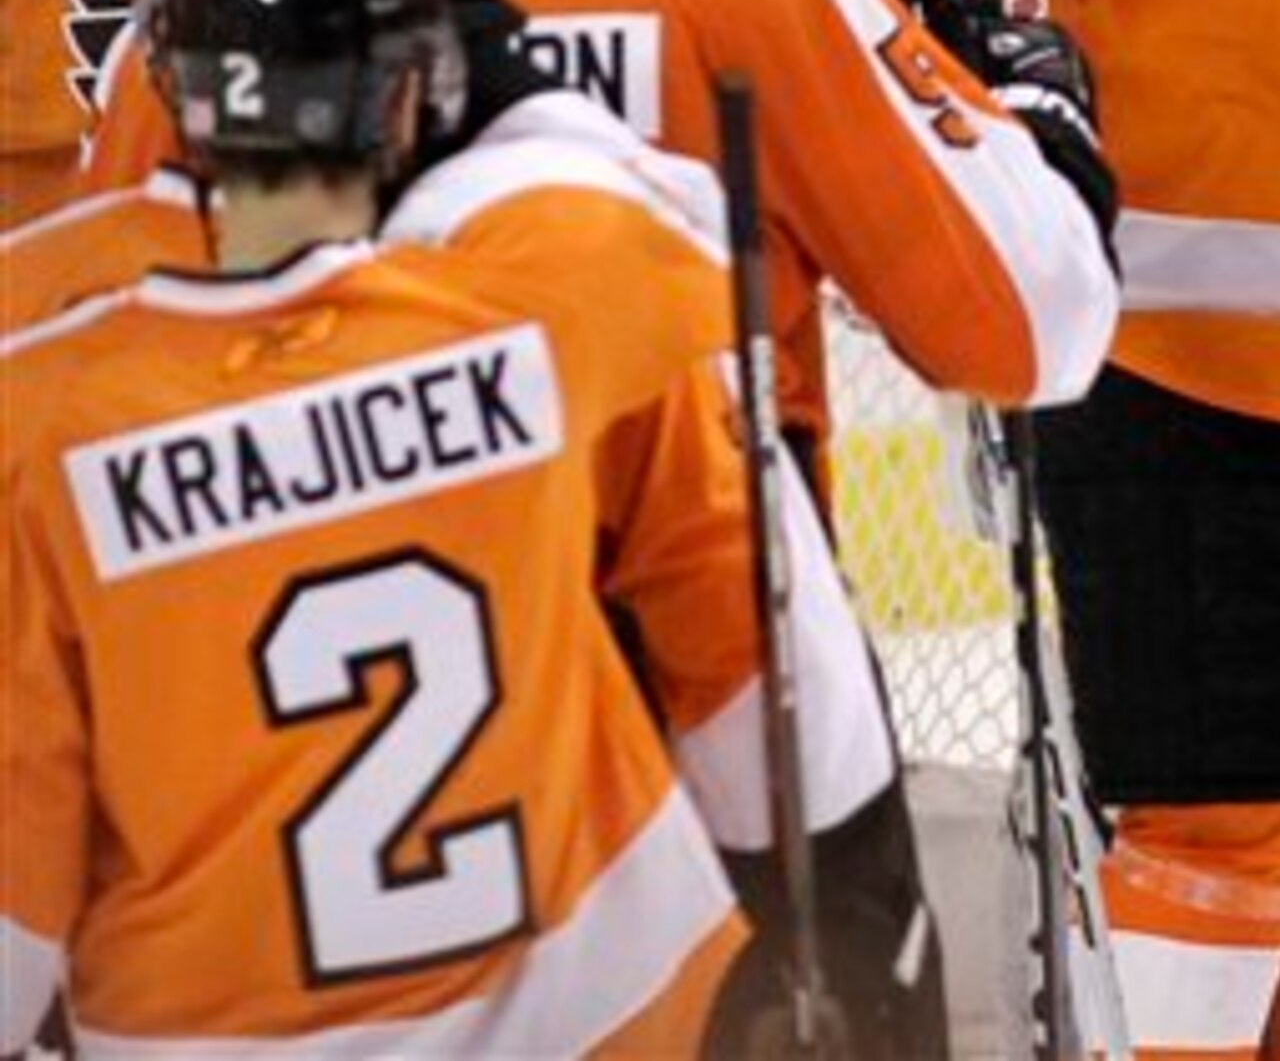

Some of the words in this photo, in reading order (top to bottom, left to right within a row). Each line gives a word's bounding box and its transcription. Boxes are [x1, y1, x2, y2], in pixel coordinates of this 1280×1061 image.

[221, 54, 264, 117] 2
[106, 351, 531, 551] KRAJICEK
[251, 545, 538, 990] 2
